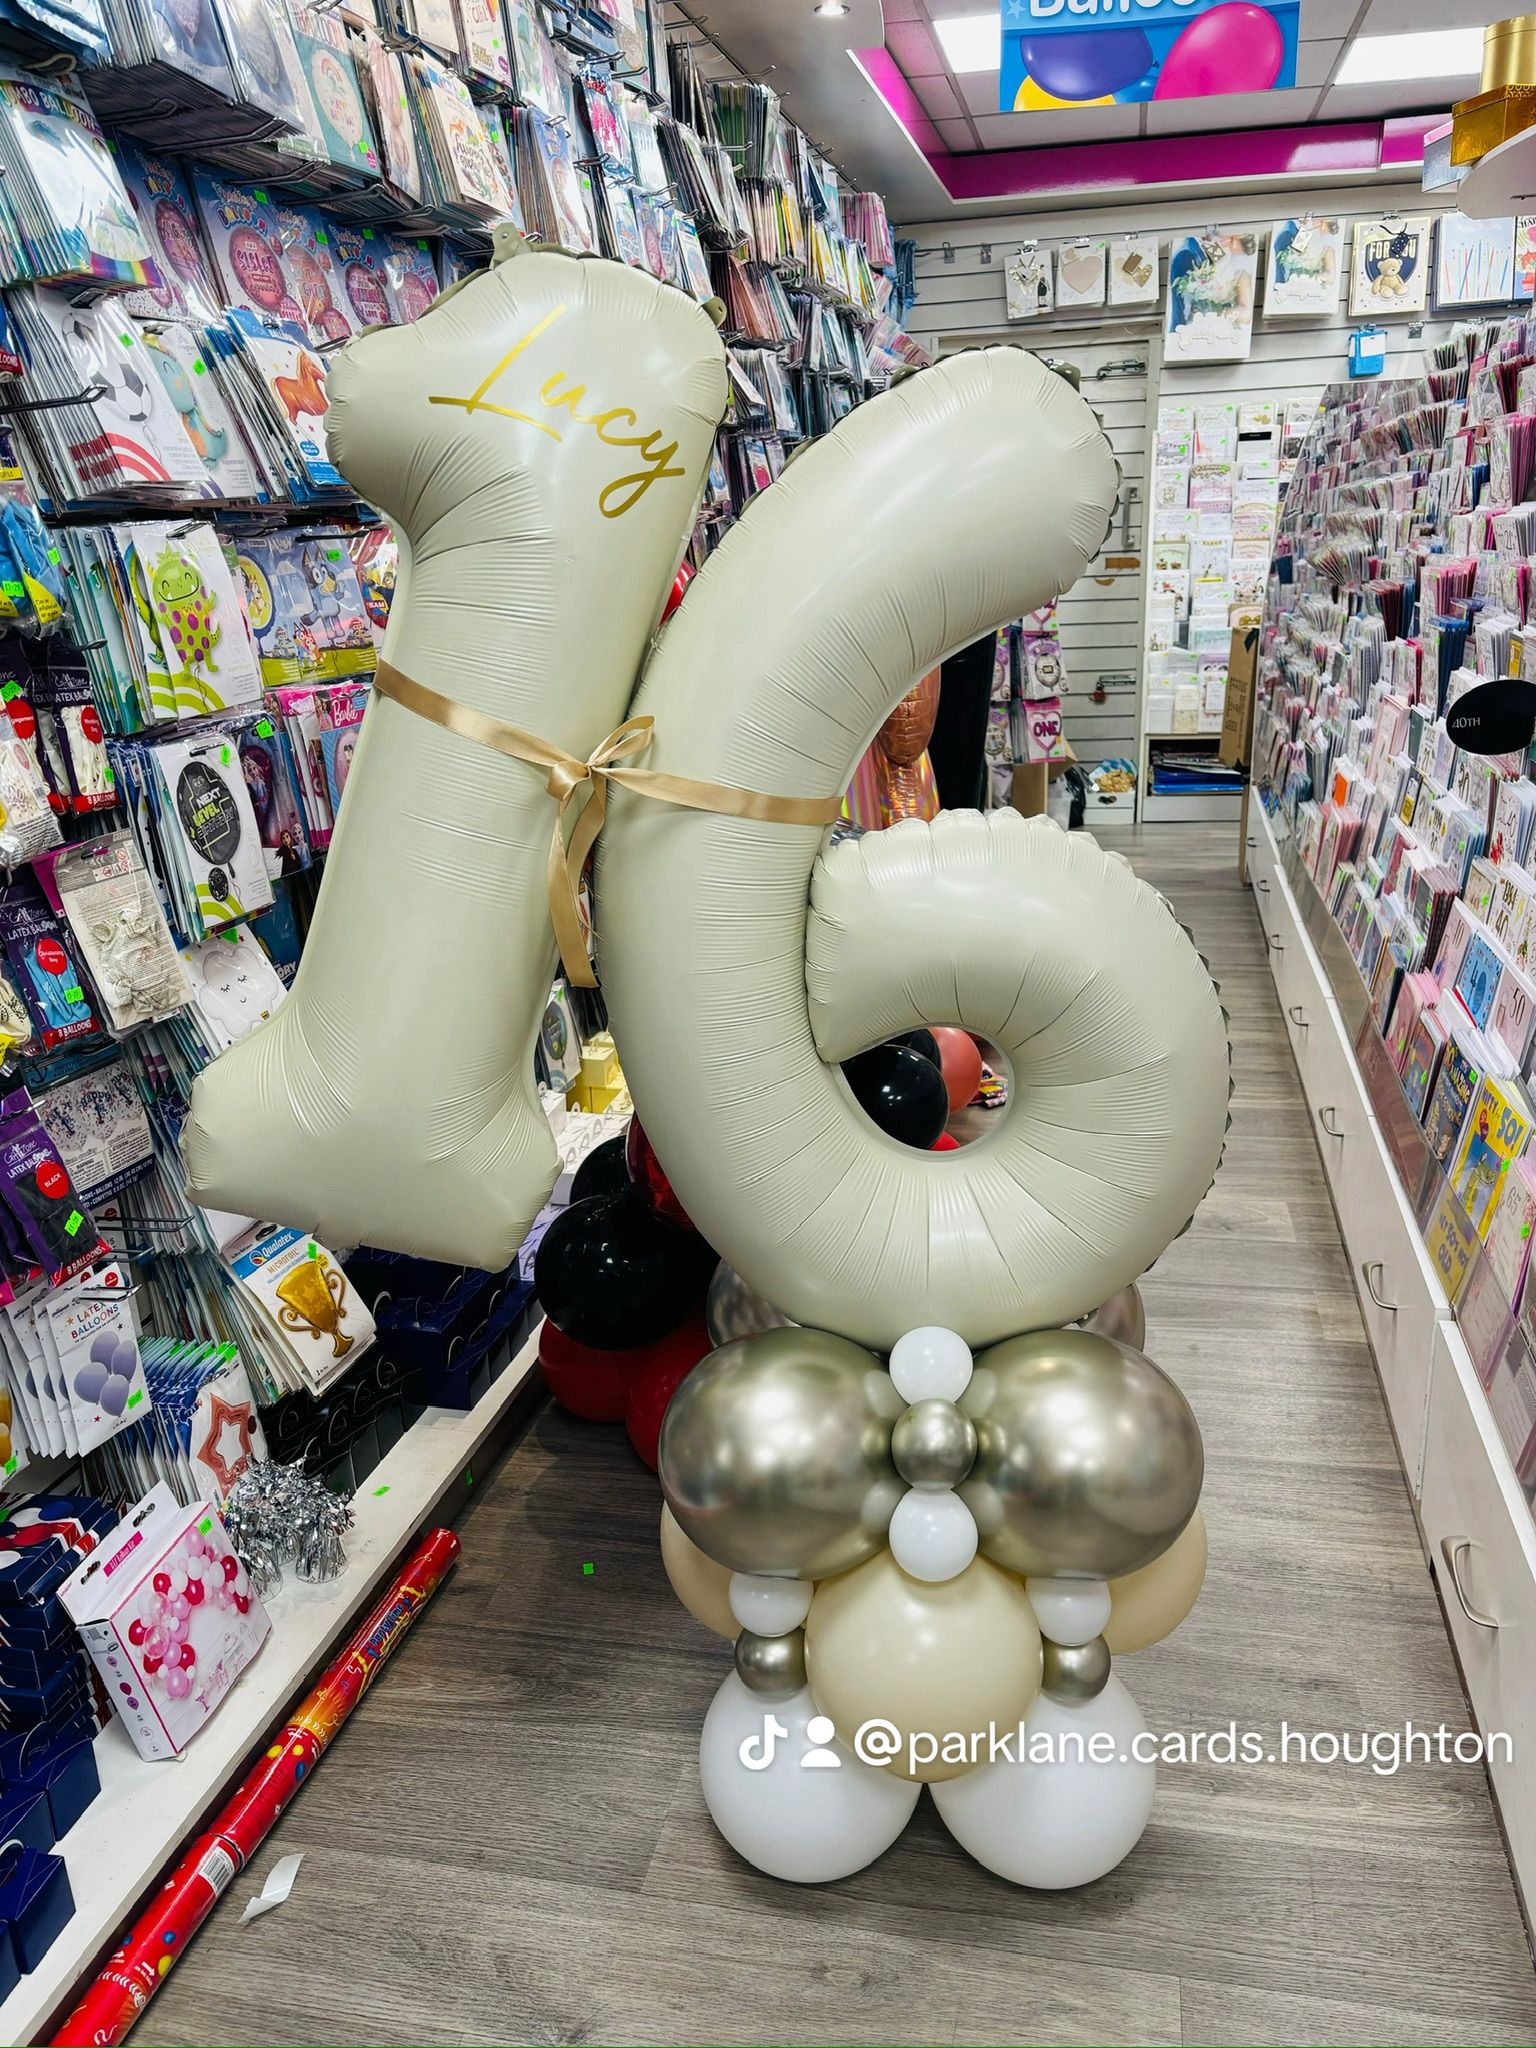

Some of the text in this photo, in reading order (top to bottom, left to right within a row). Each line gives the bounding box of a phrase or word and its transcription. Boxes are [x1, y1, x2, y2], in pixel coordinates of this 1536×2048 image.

[1369, 241, 1391, 260] FOR
[427, 303, 686, 519] Lucy
[331, 697, 359, 726] Barbie
[1033, 720, 1060, 737] ONE
[1451, 717, 1481, 728] 40TH
[196, 788, 220, 807] NEXT
[192, 802, 220, 827] LEVEL
[196, 807, 235, 840] BIRTHDAY
[63, 1019, 92, 1037] BALLOONS
[6, 1163, 28, 1179] LATEX
[44, 1172, 61, 1188] BLACK
[262, 1231, 295, 1257] Qualatex
[71, 1246, 104, 1272] BALLOONS
[71, 1303, 119, 1339] BALLOONS
[77, 1300, 107, 1323] LATEX
[112, 1417, 128, 1429] LILAC
